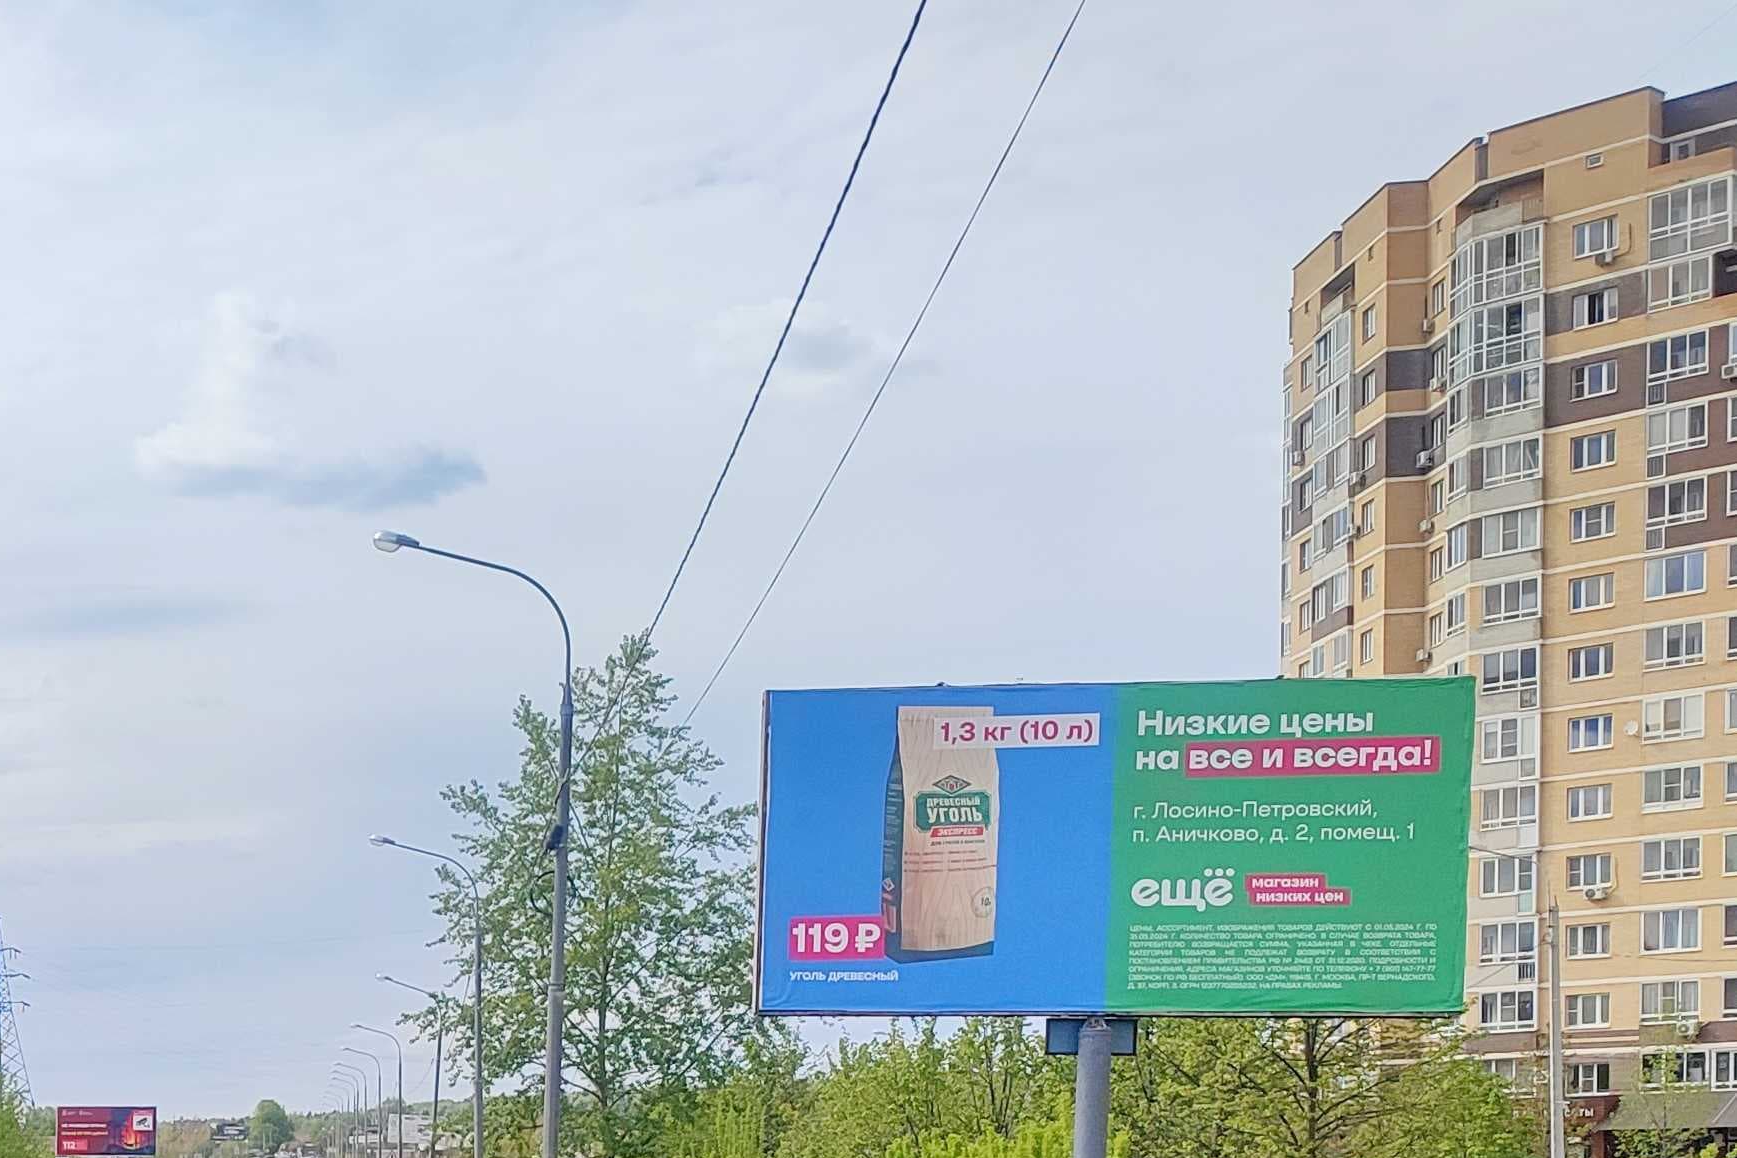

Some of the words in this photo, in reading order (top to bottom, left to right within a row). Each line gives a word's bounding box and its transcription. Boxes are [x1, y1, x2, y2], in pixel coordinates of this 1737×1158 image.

[940, 721, 976, 745] 1,3
[983, 725, 1012, 741] кг
[1019, 720, 1059, 744] (10
[1066, 719, 1093, 743] л)
[1137, 710, 1271, 736] Низкие
[1279, 711, 1374, 738] цены
[1135, 750, 1179, 770] на
[1189, 748, 1253, 769] все
[1262, 747, 1283, 768] и
[1293, 739, 1432, 771] всегда!
[926, 806, 983, 823] УГОЛЬ
[1133, 804, 1146, 820] г.
[1151, 799, 1378, 821] Лосино-Петровский,
[1132, 829, 1149, 843] п.
[1154, 825, 1264, 845] Аничково,
[1269, 827, 1289, 844] д.
[1294, 823, 1314, 843] 2,
[1319, 826, 1400, 844] помещ.
[1405, 822, 1415, 840] 1
[1130, 868, 1236, 912] ещё
[1251, 877, 1319, 888] магазин
[1255, 891, 1312, 903] низких
[1314, 891, 1344, 904] цен
[792, 922, 849, 953] 119
[854, 923, 881, 953] ₽
[789, 970, 826, 982] УГОЛЬ
[827, 969, 899, 982] ДРЕВЕСНЫЙ
